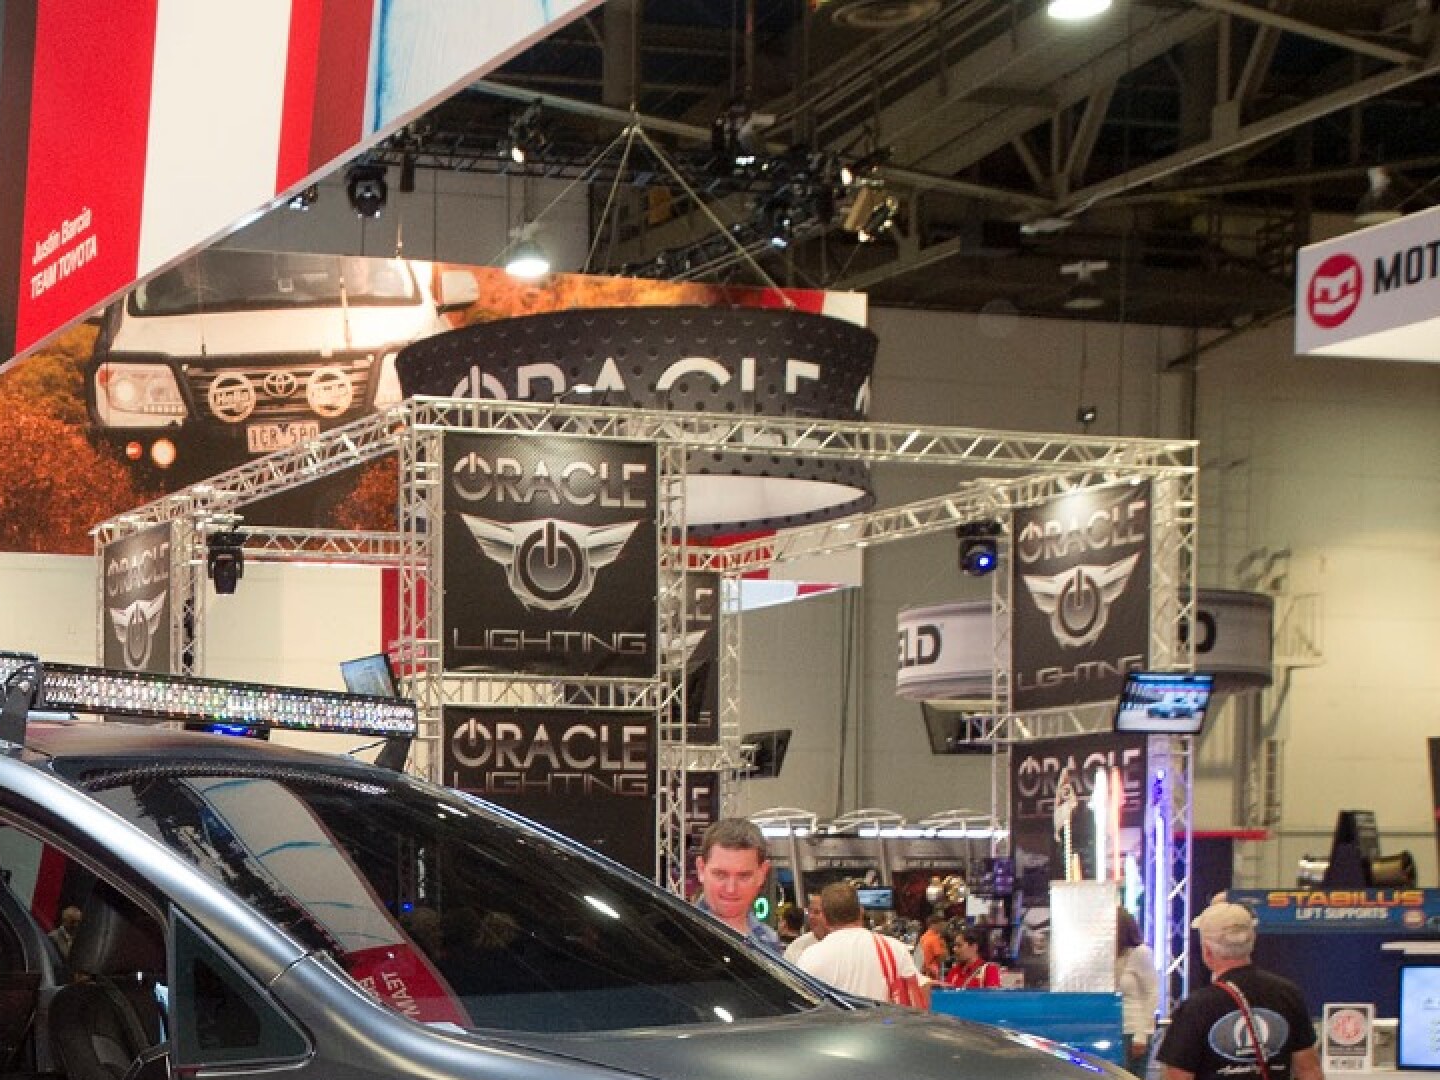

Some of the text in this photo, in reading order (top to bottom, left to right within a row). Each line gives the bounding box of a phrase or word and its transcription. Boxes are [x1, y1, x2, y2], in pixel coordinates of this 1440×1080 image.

[32, 230, 60, 266] Justin
[30, 233, 97, 300] TEAM TOYOTA
[453, 451, 647, 508] ORACLE
[1018, 502, 1146, 564] ORACLE
[453, 627, 647, 655] LIGHTING
[452, 717, 648, 771] ORACLE
[453, 770, 649, 797] LIGHTING
[1267, 888, 1424, 908] STABILUS
[1296, 907, 1388, 920] LIFT SUPPORTS
